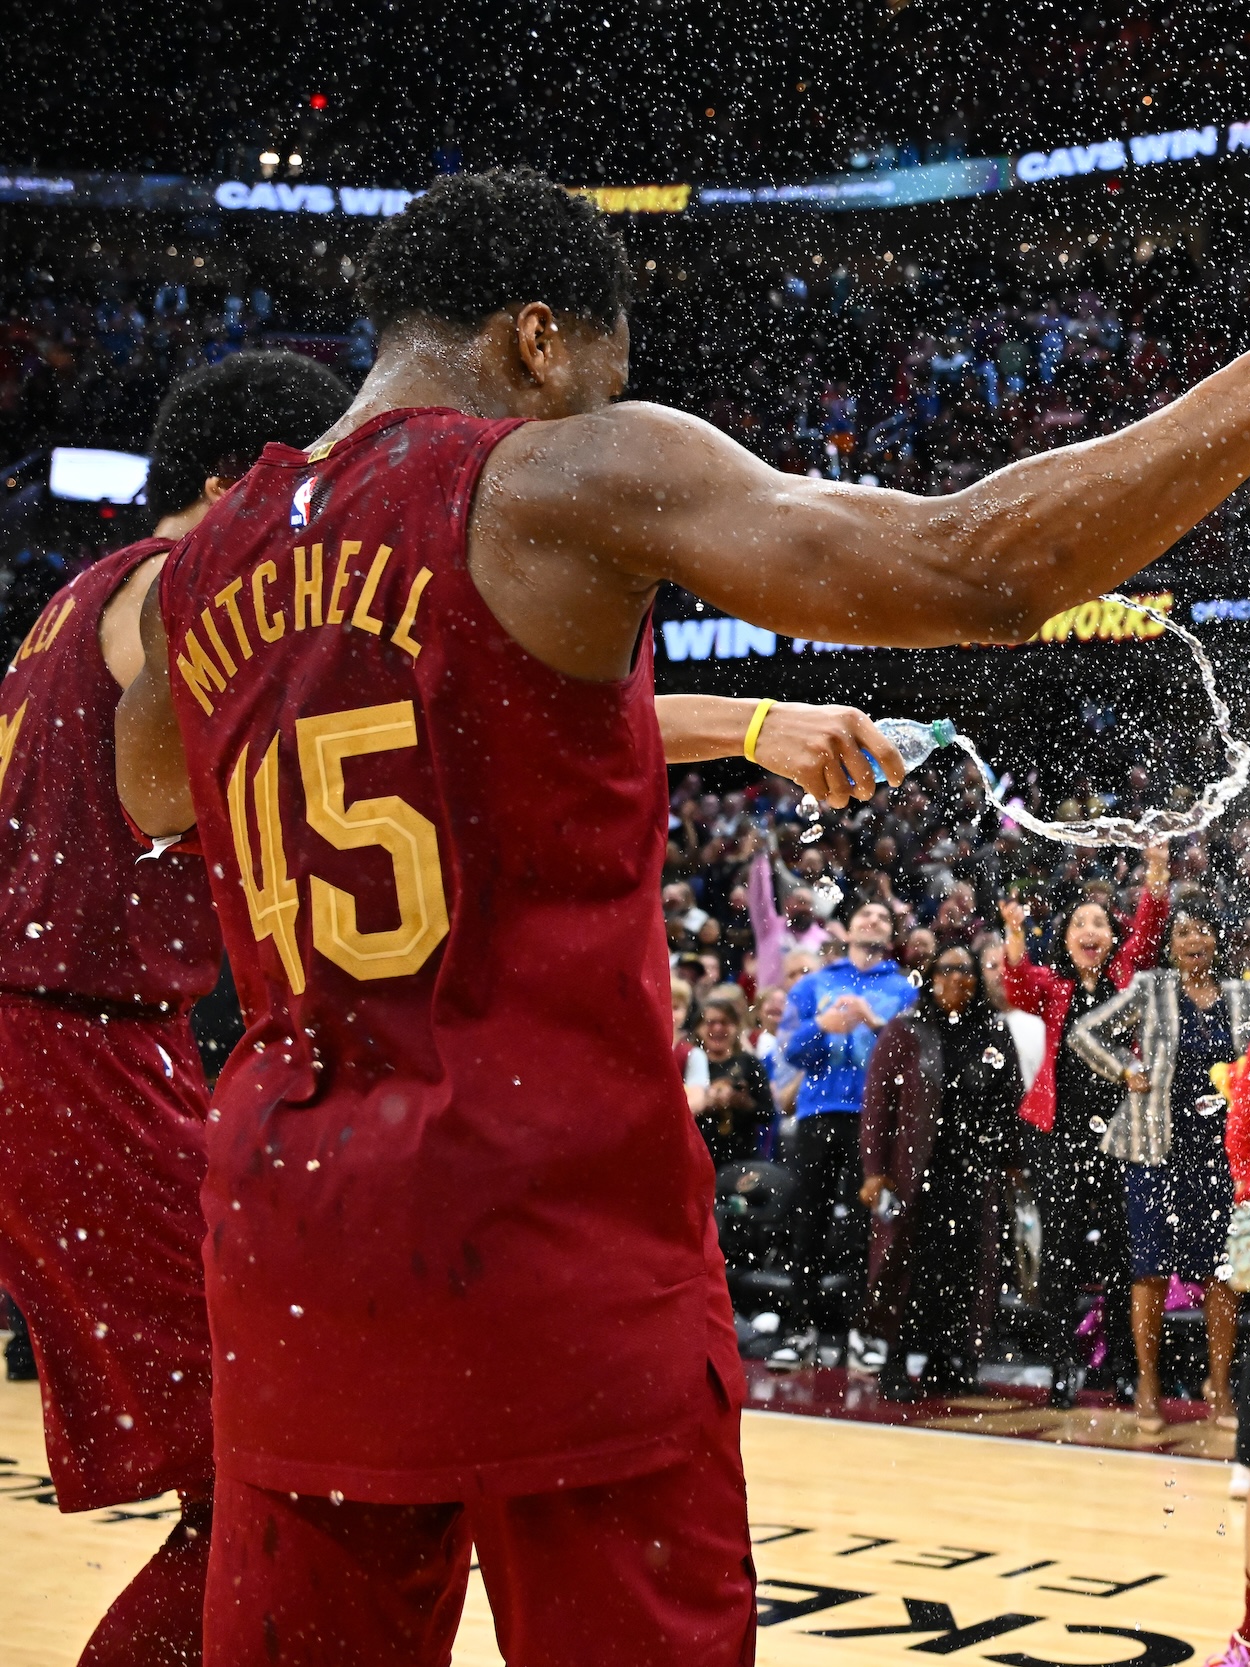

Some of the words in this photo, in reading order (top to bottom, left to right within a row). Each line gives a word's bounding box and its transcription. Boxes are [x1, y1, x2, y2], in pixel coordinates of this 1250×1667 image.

[1016, 140, 1127, 183] CAVS
[1129, 125, 1218, 166] WIN
[215, 180, 336, 213] CAVS
[176, 540, 433, 717] MITCHELL
[663, 617, 777, 662] WIN
[227, 700, 450, 996] 45
